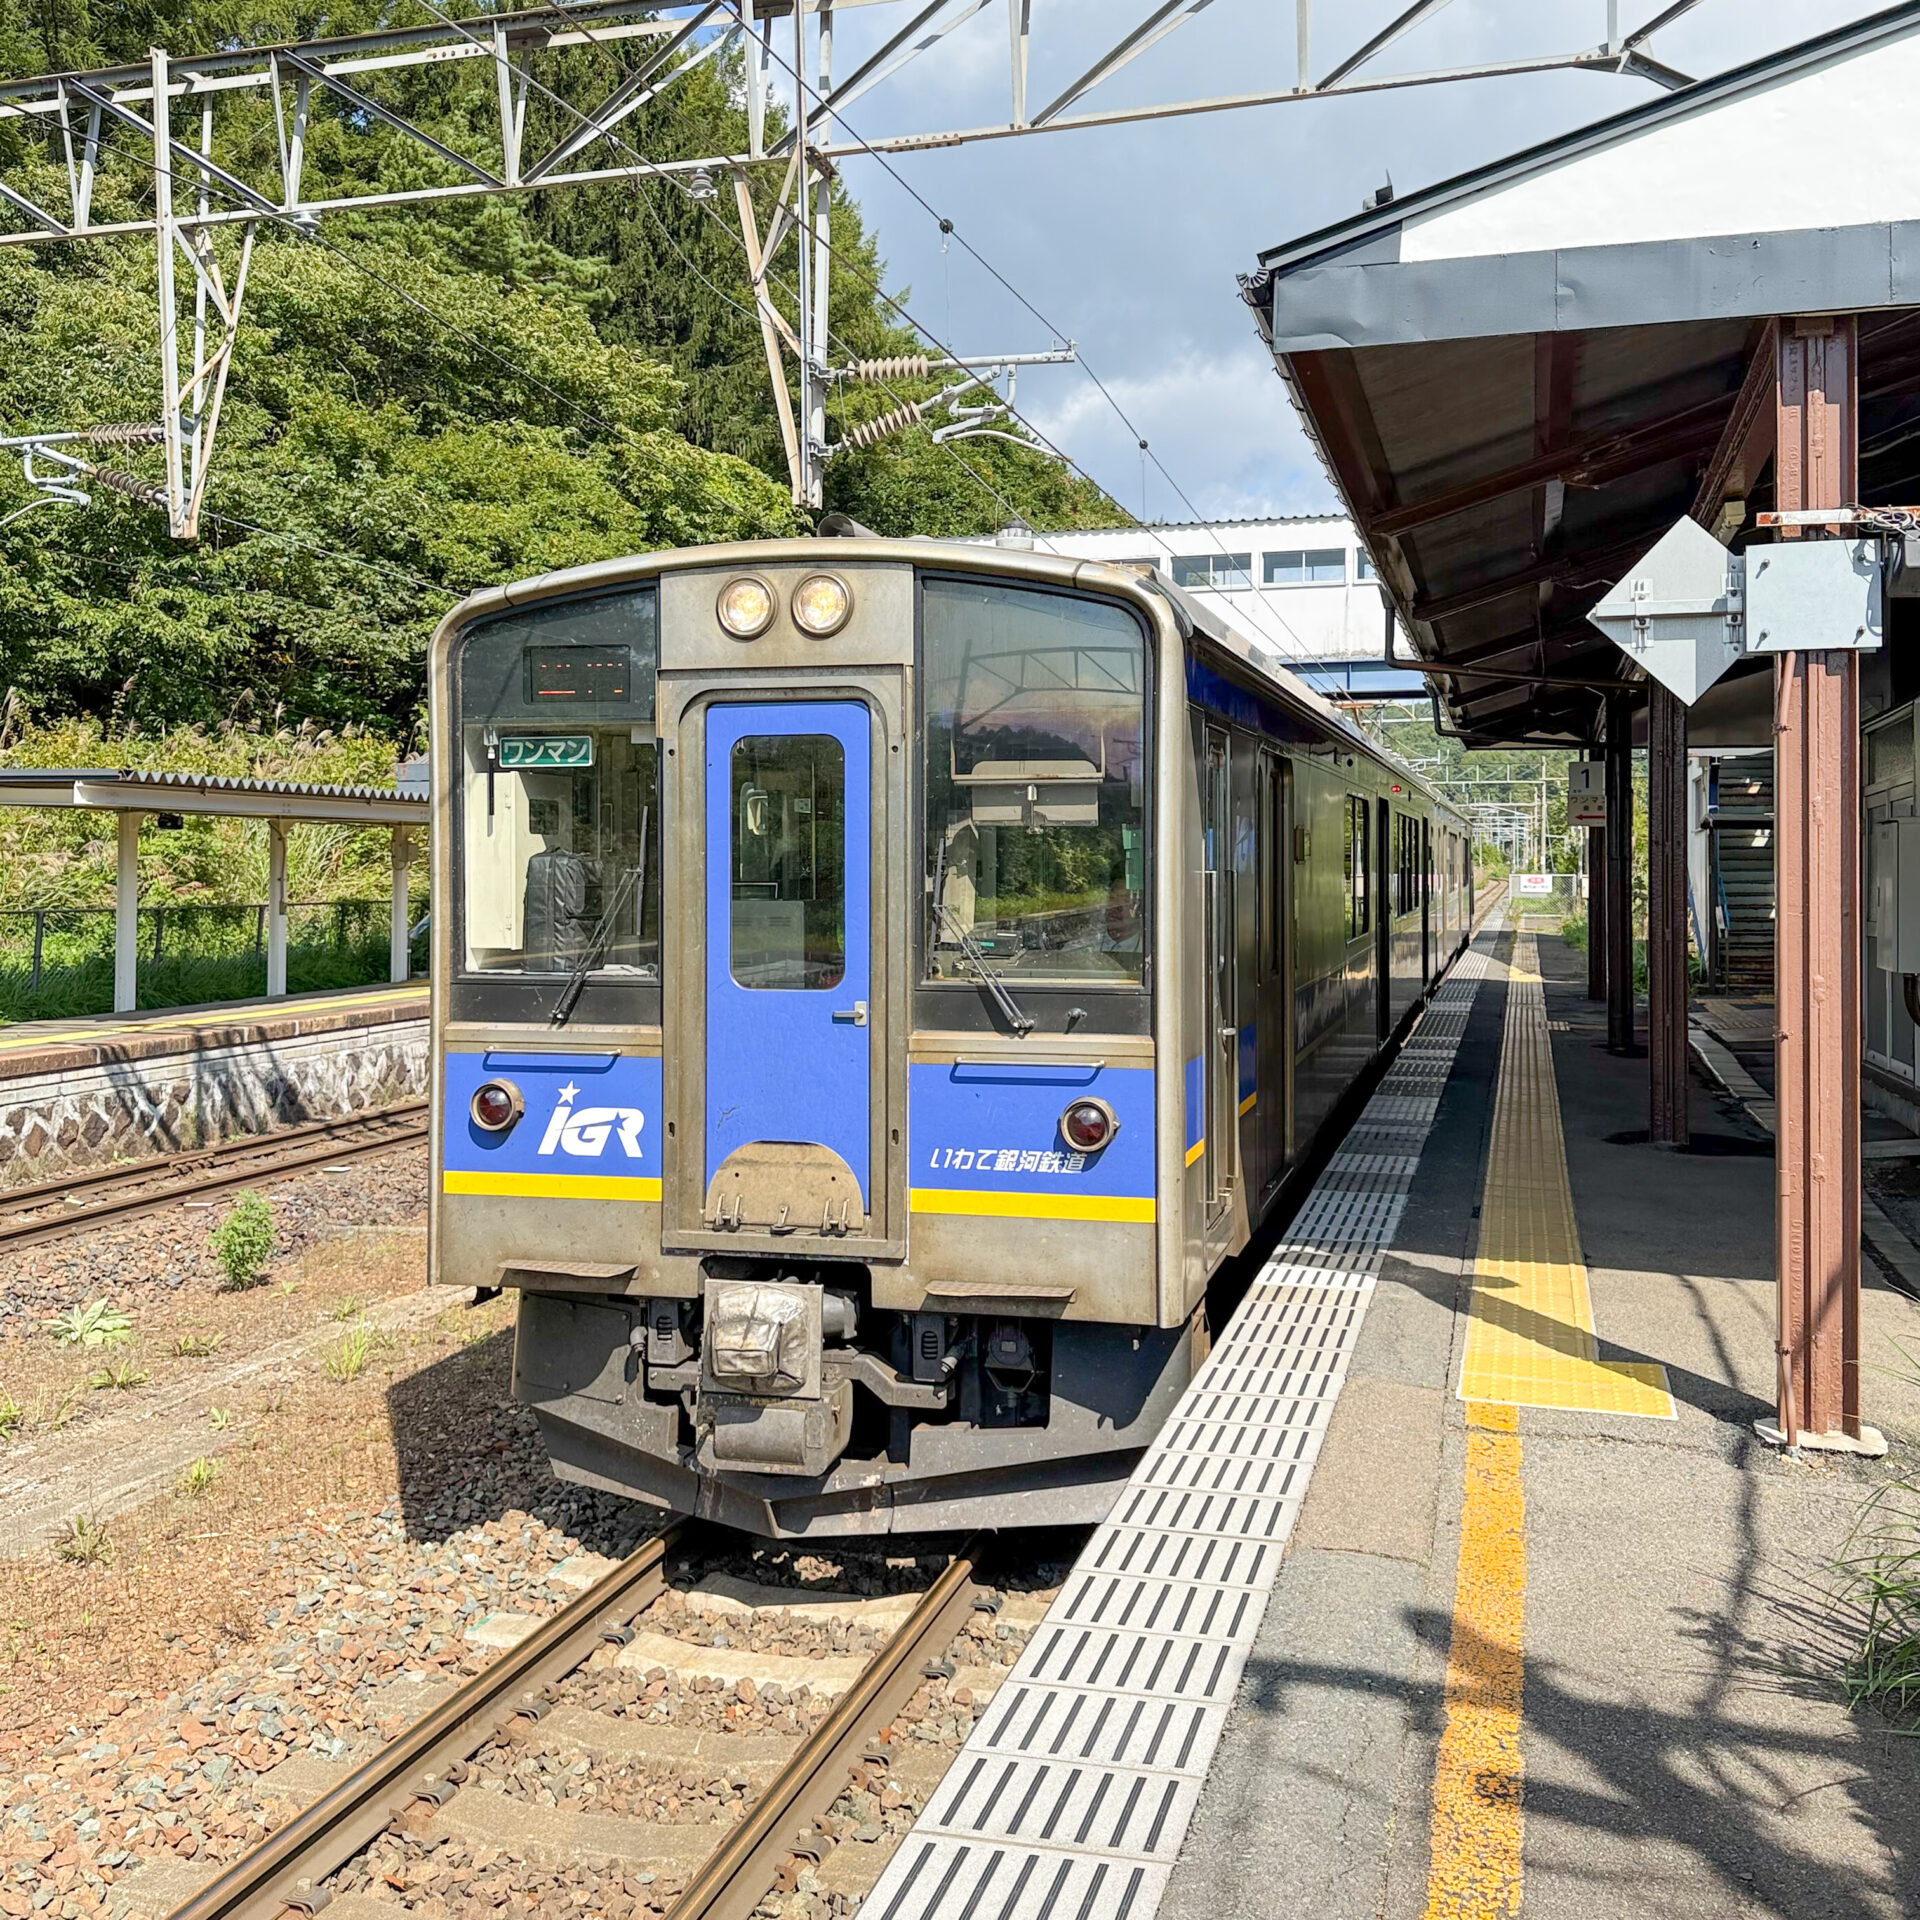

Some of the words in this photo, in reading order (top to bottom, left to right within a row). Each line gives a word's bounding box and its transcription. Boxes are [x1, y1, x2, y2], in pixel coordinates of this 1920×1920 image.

[504, 740, 588, 764] ワンマン
[1580, 768, 1590, 789] 1
[929, 1148, 1087, 1174] いわて銀河鉄道
